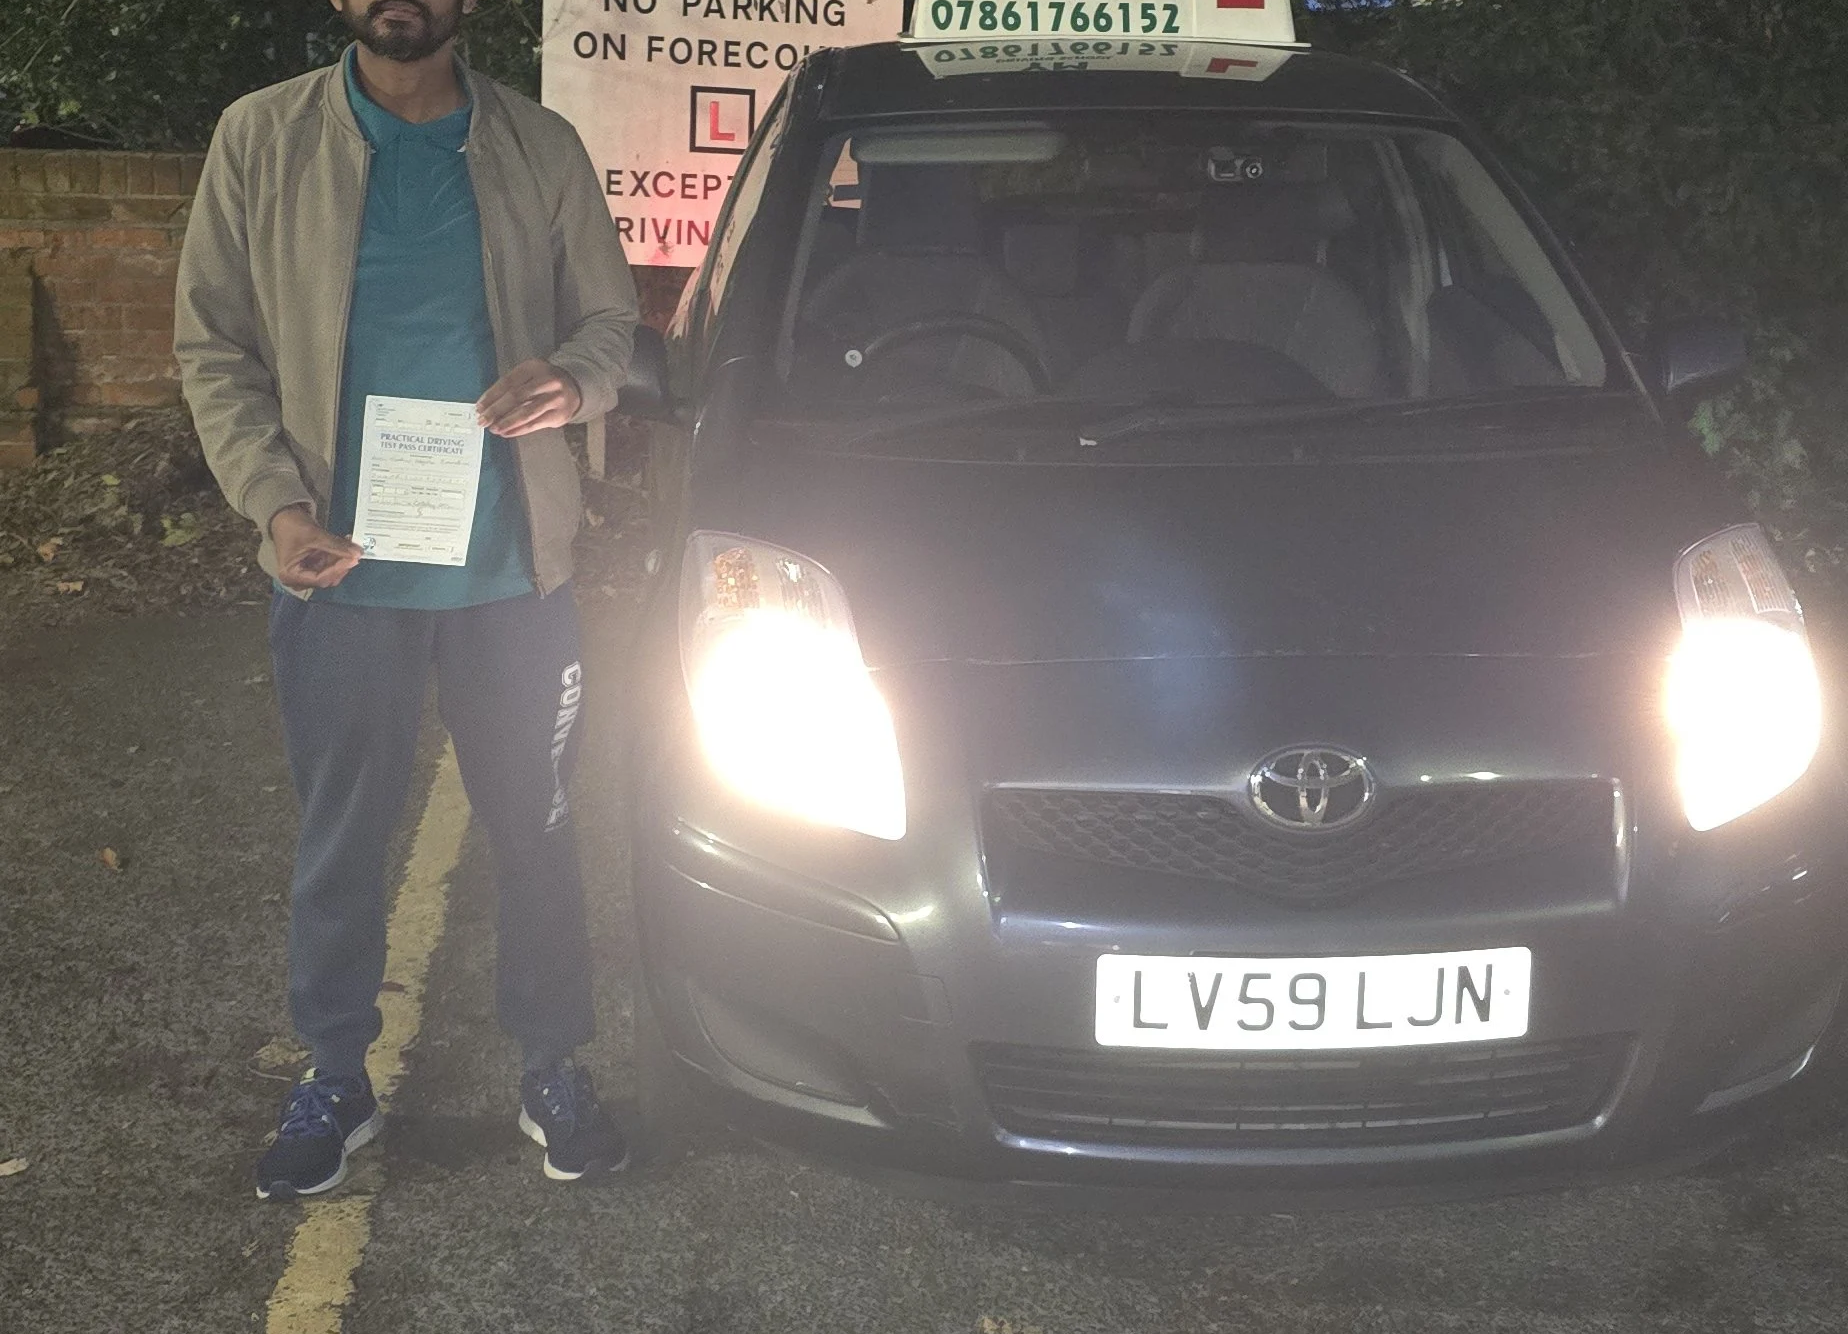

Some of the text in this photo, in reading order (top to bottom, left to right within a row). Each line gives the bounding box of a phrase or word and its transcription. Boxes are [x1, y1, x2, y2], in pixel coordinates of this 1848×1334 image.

[931, 0, 1181, 34] 07861766152
[573, 31, 824, 71] ON FORECO
[709, 100, 736, 141] L
[606, 169, 735, 200] EXCEP
[615, 216, 710, 246] RIVIN
[380, 432, 465, 447] PRACTICAL DRIVING
[381, 441, 397, 450] TEST
[399, 443, 417, 452] PASS
[418, 444, 464, 456] CERTIFICATE
[1133, 964, 1493, 1031] LV59 LJN
